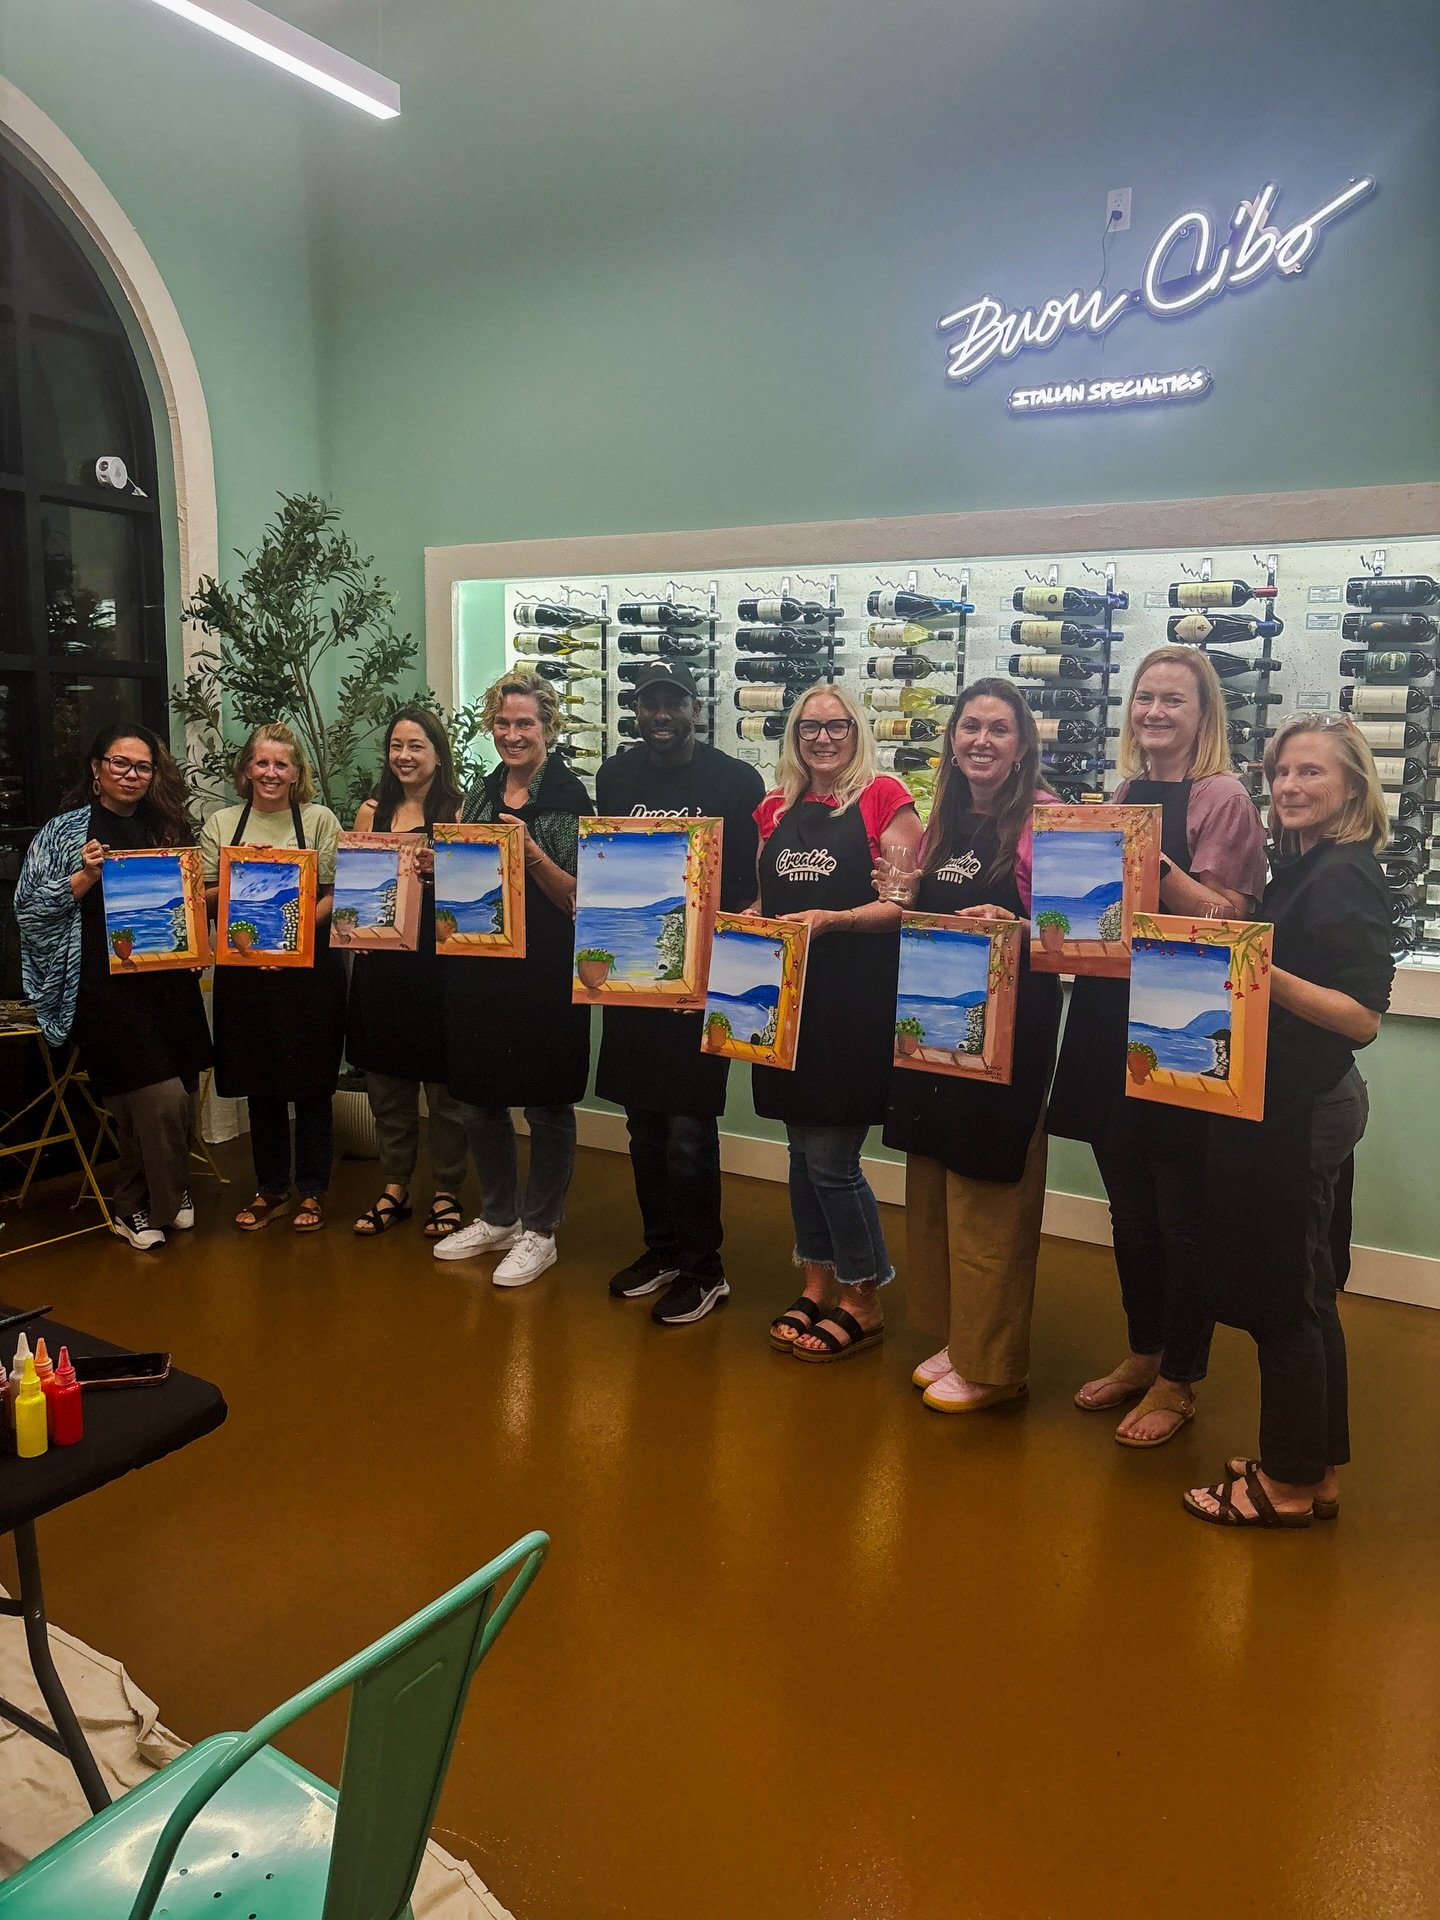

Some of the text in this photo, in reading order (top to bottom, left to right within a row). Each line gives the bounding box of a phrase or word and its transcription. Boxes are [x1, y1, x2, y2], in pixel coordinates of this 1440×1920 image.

[938, 178, 1373, 379] Buon Cibo
[1012, 370, 1204, 406] ITALIAN SPECIALTIES
[776, 848, 837, 874] Creative
[788, 871, 820, 882] CANVAS
[937, 871, 964, 885] CANVAS
